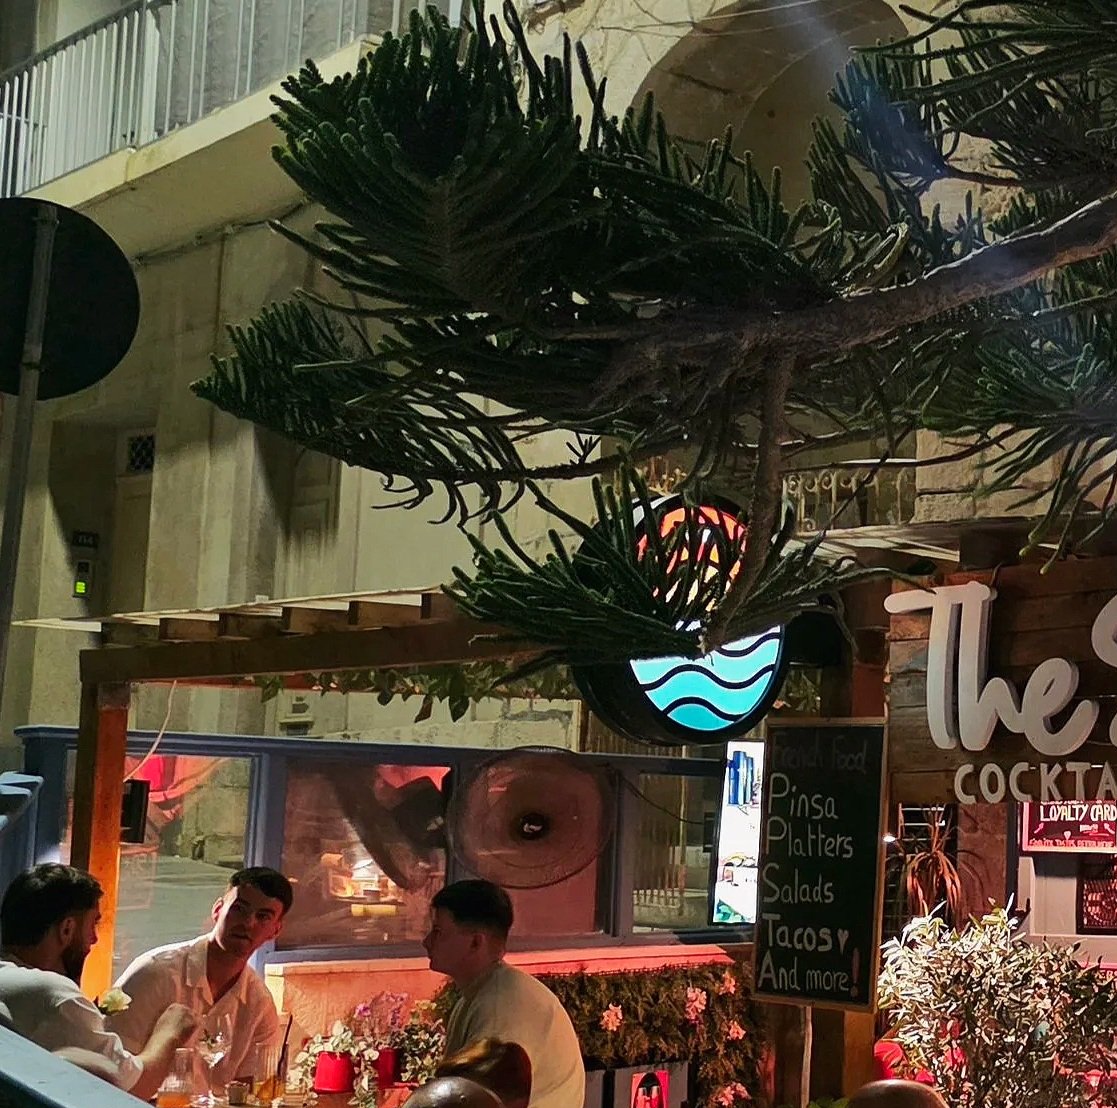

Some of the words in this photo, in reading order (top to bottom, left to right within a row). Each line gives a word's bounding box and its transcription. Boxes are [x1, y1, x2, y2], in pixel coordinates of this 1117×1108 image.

[884, 579, 1099, 755] The
[768, 772, 839, 819] Pinsa
[1040, 804, 1088, 822] LOYALTY
[1090, 804, 1117, 822] CARD
[766, 816, 853, 858] Platters
[762, 862, 834, 904] Salads
[762, 913, 833, 951] Tacos
[758, 949, 801, 990] And
